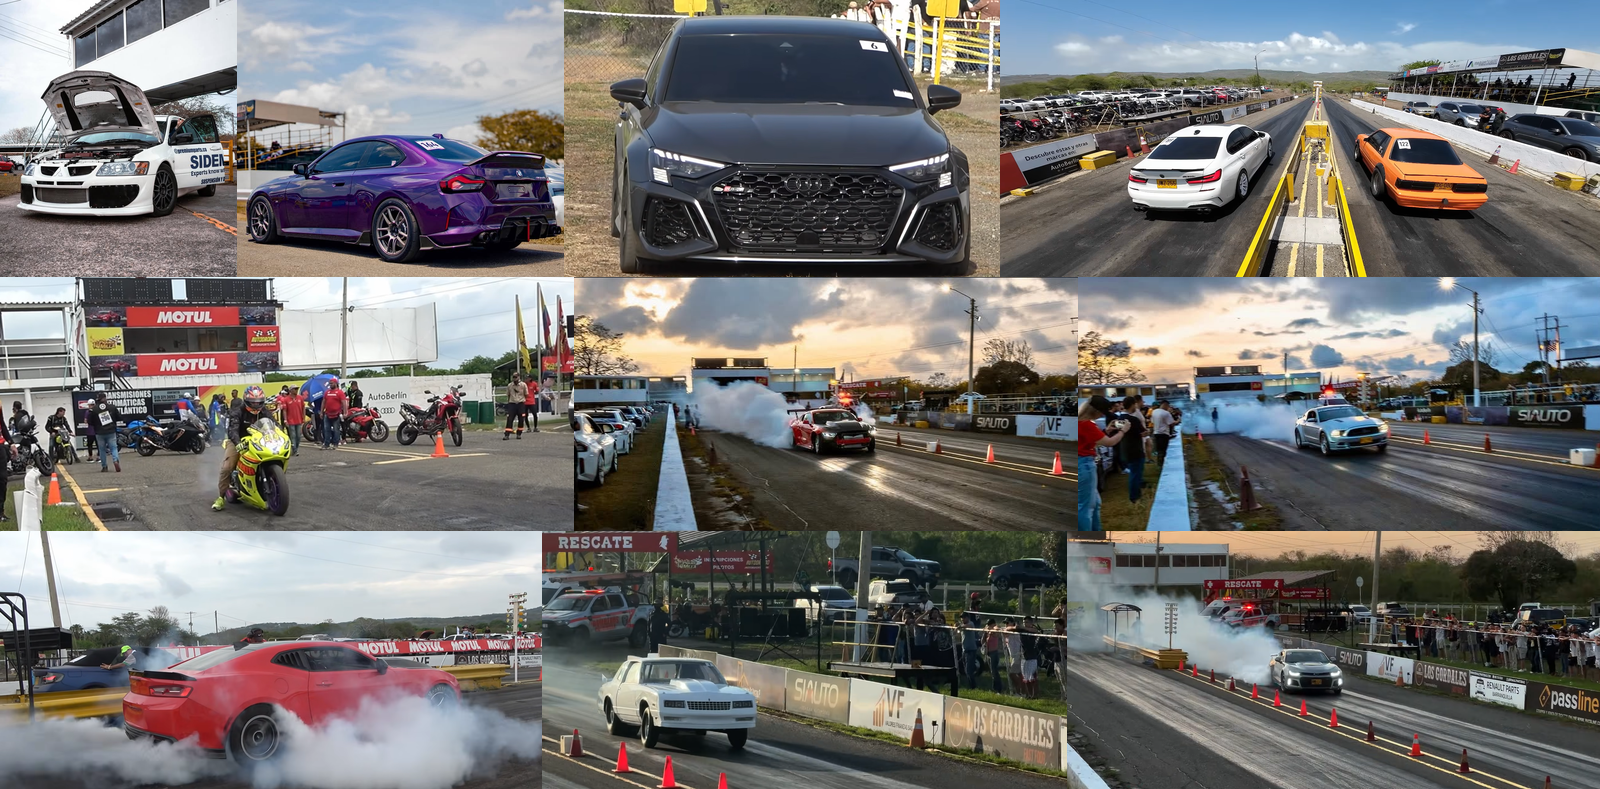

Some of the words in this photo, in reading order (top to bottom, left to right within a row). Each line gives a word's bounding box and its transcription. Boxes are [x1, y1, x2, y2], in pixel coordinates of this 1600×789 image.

[870, 42, 878, 50] 6
[1195, 112, 1220, 125] SIAUTO
[1024, 150, 1055, 162] Descubre
[1046, 153, 1067, 162] marcas
[156, 310, 213, 324] MOTUL
[160, 357, 218, 372] MOTUL
[104, 390, 152, 399] RANSMISIONES
[117, 405, 148, 415] TLÁNTICO
[1517, 409, 1572, 422] SIAUTO
[976, 417, 1010, 429] SIAUTO
[1046, 417, 1063, 431] VF
[558, 536, 633, 550] RESCATE
[408, 641, 444, 653] MOTUL
[451, 640, 481, 651] MOTUL
[487, 640, 511, 650] MOTUL
[467, 655, 479, 664] LOS
[1339, 651, 1363, 667] SIAUTO
[1385, 657, 1395, 672] VF
[1424, 664, 1435, 680] LOS
[1435, 667, 1467, 687] GORDALES
[793, 677, 839, 708] SIAUTO
[1486, 681, 1505, 692] RENAULT
[1505, 684, 1520, 695] PARTS
[886, 687, 905, 719] VF
[1550, 690, 1600, 714] passline
[966, 705, 987, 735] LOS
[989, 709, 1055, 750] GORDALES
